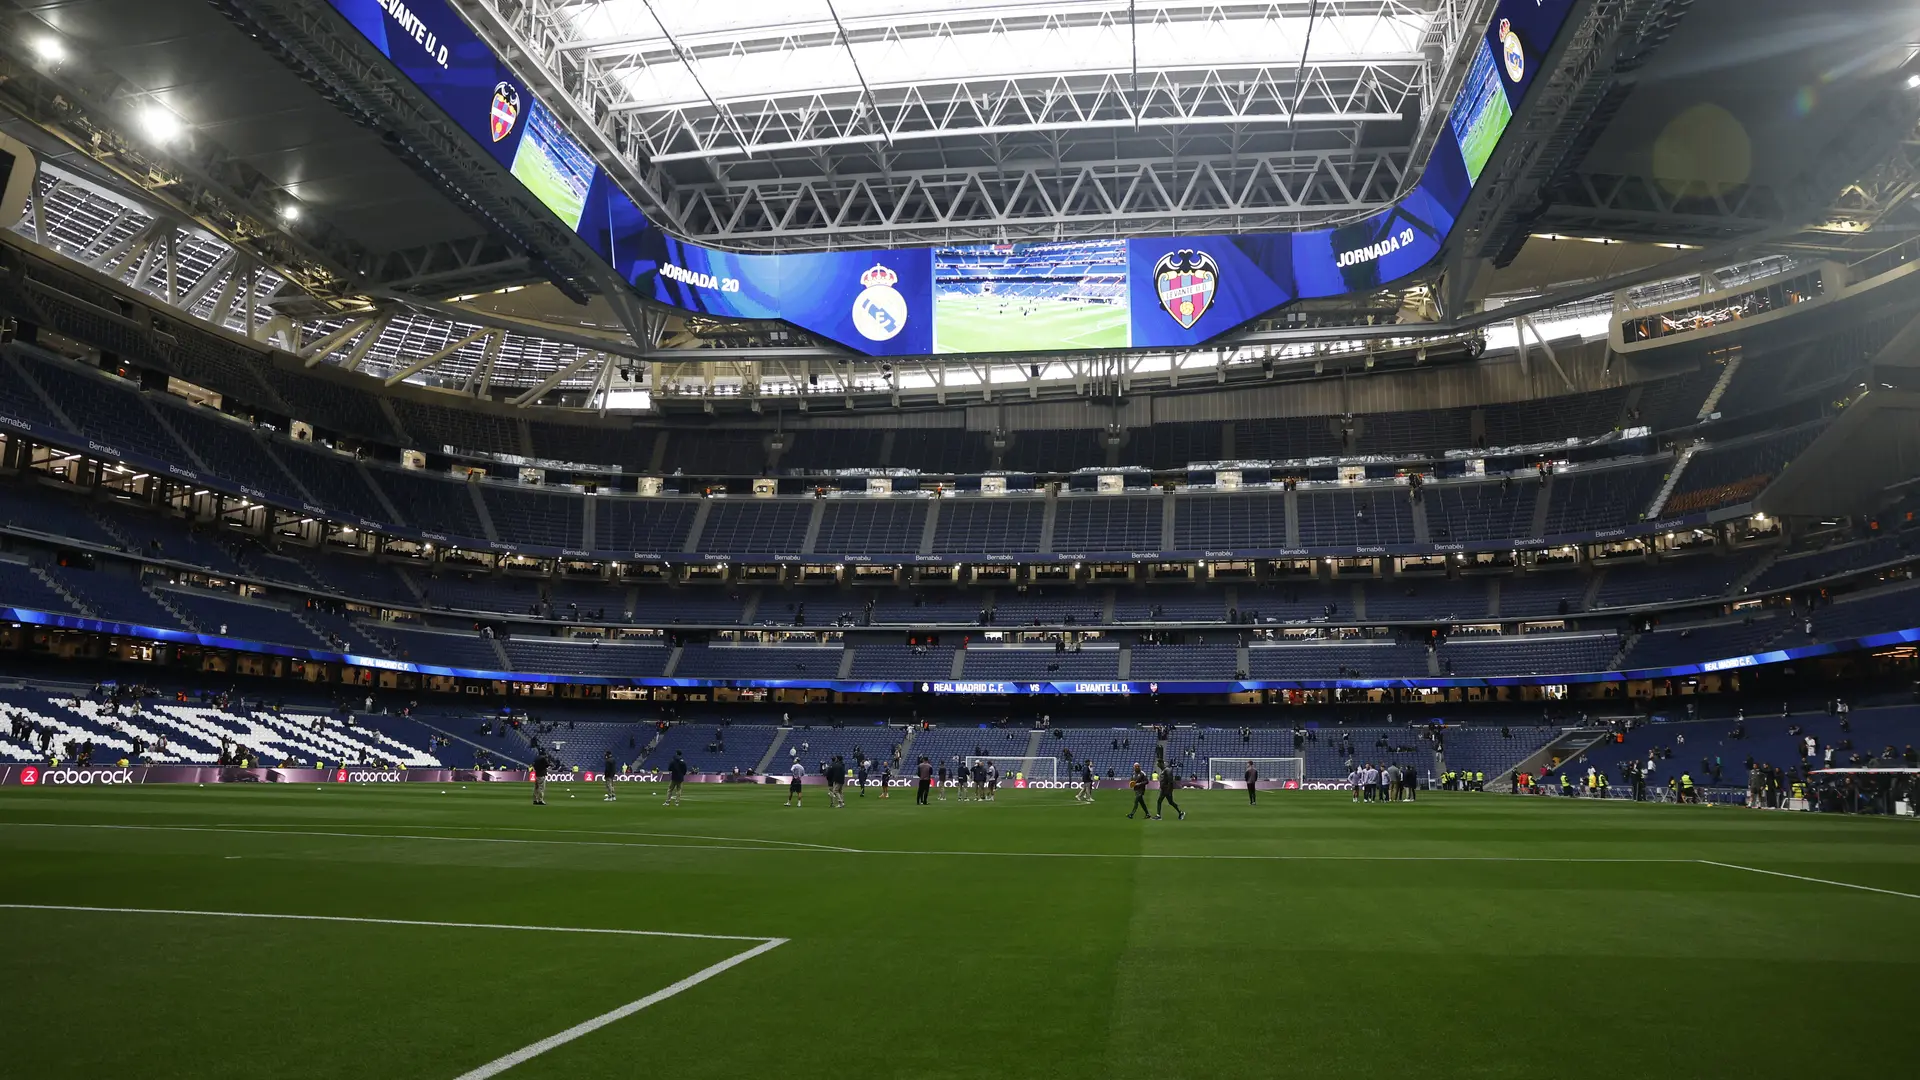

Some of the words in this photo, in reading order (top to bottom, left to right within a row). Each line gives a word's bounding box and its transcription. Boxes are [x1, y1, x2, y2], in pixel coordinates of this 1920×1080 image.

[376, 0, 427, 44] EVANTE
[425, 32, 436, 57] U.
[437, 44, 448, 70] D.
[1336, 236, 1400, 268] JORNADA
[1400, 228, 1414, 246] 20
[659, 262, 718, 290] JORNADA
[721, 278, 740, 292] 20
[0, 415, 32, 431] ernabéu
[89, 440, 121, 457] Bernabéu
[169, 464, 198, 479] Bernabéu
[303, 502, 326, 515] Bernabéu
[360, 518, 383, 531] Bernabéu
[1655, 519, 1684, 530] Bernabéu
[421, 531, 447, 542] Bernabéu
[1595, 528, 1626, 538] Bernabéu
[490, 541, 518, 551] Bernabéu
[1514, 537, 1545, 547] Bernabéu
[1280, 548, 1309, 556] Bernabéu
[1356, 545, 1386, 554] Bernabéu
[1434, 543, 1464, 552] Bernabéu
[562, 548, 590, 557] Bernabéu
[634, 552, 661, 560] Bernabéu
[704, 553, 731, 561] Bernabéu
[1058, 553, 1086, 561] Bernabéu
[1131, 551, 1159, 559] Bernabéu
[1205, 550, 1234, 558] Bernabéu
[774, 554, 801, 562] Bernabéu
[844, 554, 872, 562] Bernabéu
[915, 554, 942, 562] Bernabéu
[934, 683, 954, 692] REAL
[956, 683, 986, 692] MADRID
[988, 683, 996, 692] C.
[998, 683, 1004, 692] F.
[1030, 684, 1040, 692] VS
[1076, 684, 1110, 692] LEVANTE
[1111, 684, 1120, 692] U.
[1121, 684, 1130, 692] D.
[42, 768, 133, 784] roborock
[348, 770, 401, 782] roborock
